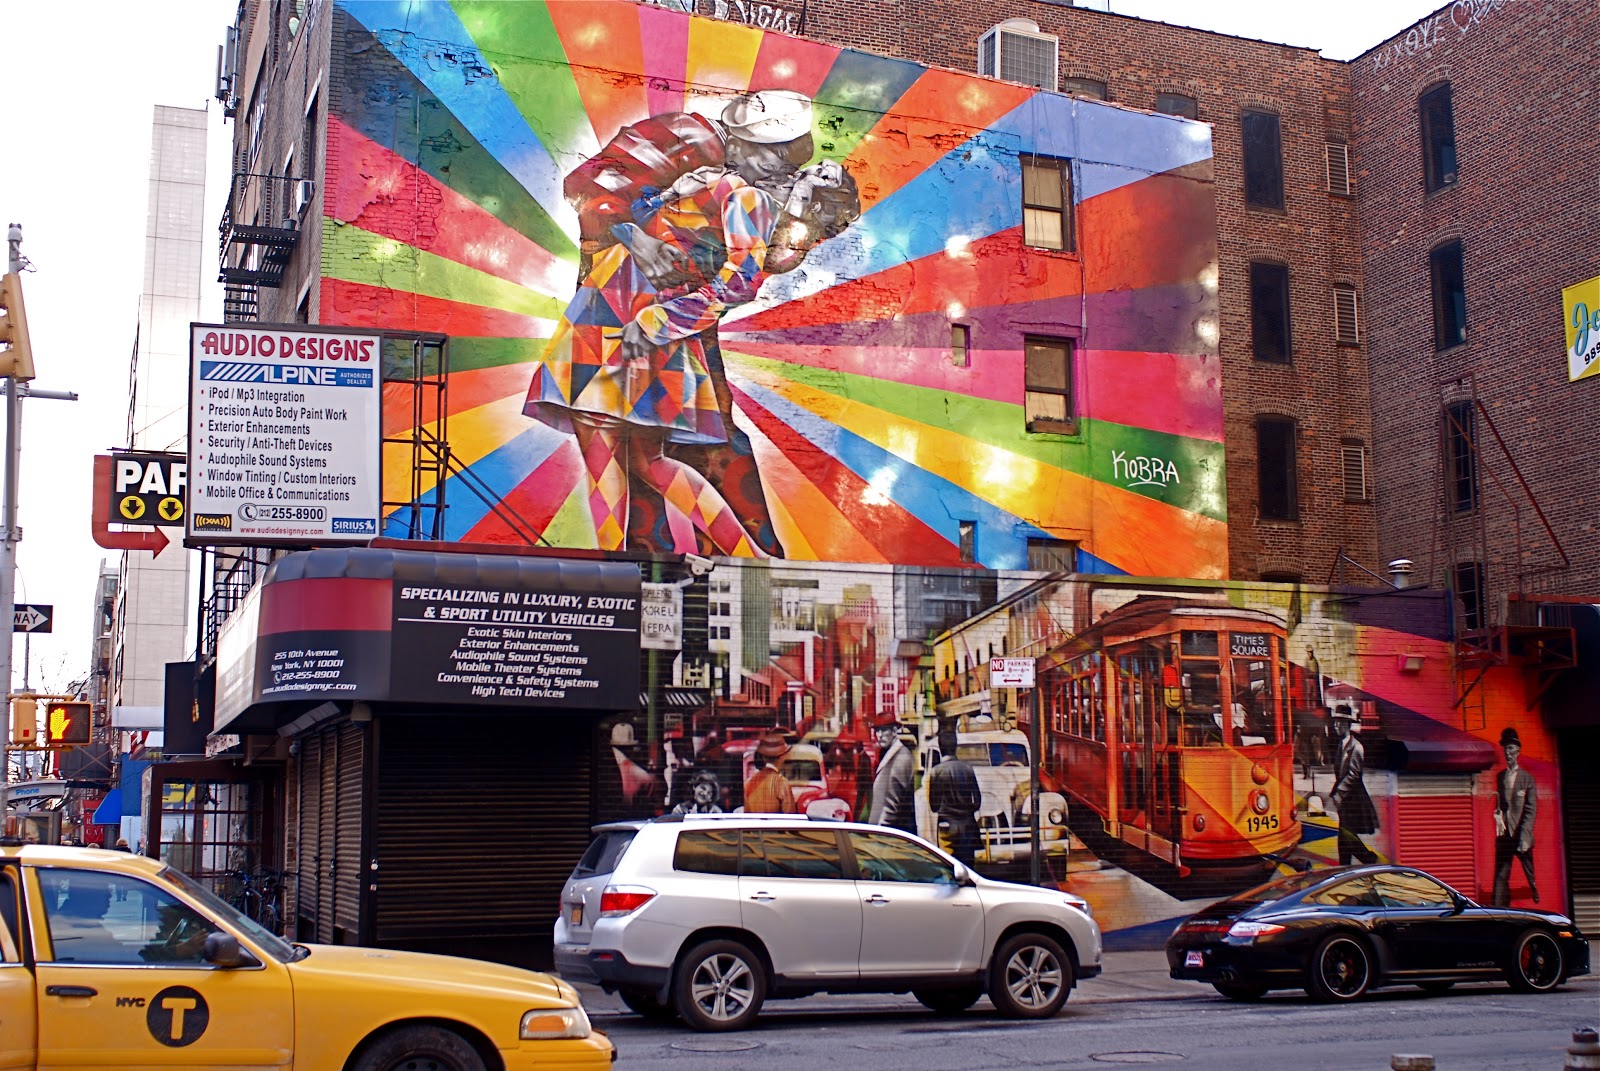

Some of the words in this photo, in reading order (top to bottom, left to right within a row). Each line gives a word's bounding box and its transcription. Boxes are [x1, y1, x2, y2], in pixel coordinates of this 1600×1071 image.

[201, 332, 275, 357] AUDIO
[280, 336, 375, 362] DESIGNS
[247, 365, 337, 385] ALPINE
[209, 387, 229, 399] iPod
[236, 388, 255, 402] Mp3
[257, 389, 305, 404] Integration
[208, 404, 251, 416] Precision
[252, 405, 274, 418] Auto
[275, 406, 299, 421] Body
[300, 408, 323, 420] Paint
[325, 408, 348, 420] Work
[208, 420, 244, 432] Exterior
[246, 421, 311, 435] Enhancements
[208, 435, 245, 451] Security
[252, 437, 296, 450] Anti-Theft
[298, 439, 333, 452] Devices
[208, 452, 257, 468] Audiophile
[258, 453, 287, 467] Sound
[289, 455, 327, 470] Systems
[1111, 450, 1180, 484] KOBRA
[208, 469, 243, 482] Window
[245, 470, 276, 486] Tinting
[283, 471, 317, 484] Custom
[319, 473, 356, 485] Interiors
[207, 486, 236, 498] Mobile
[238, 486, 265, 499] Office
[267, 487, 274, 499] &
[276, 488, 350, 501] Communications
[271, 507, 324, 519] 255-8900
[334, 521, 365, 530] SIRIUS
[401, 587, 500, 604] SPECIALIZING
[503, 592, 520, 604] IN
[523, 593, 583, 609] LUXURY,
[587, 597, 637, 610] EXOTIC
[423, 606, 436, 619] &
[440, 607, 490, 620] SPORT
[492, 609, 548, 624] UTILITY
[551, 612, 616, 627] VEHICLES
[467, 627, 500, 638] Exotic
[502, 628, 526, 639] Skin
[527, 629, 572, 641] Interiors
[647, 622, 672, 633] FERA
[459, 638, 502, 649] Exterior
[503, 640, 580, 653] Enhancements
[1234, 635, 1265, 645] TIMES
[274, 651, 288, 660] 255
[288, 650, 304, 659] 10th
[304, 649, 339, 658] Avenue
[449, 649, 506, 662] Audiophile
[507, 652, 541, 663] Sound
[542, 653, 589, 665] Systems
[1231, 645, 1269, 657] SQUARE
[270, 664, 284, 672] New
[284, 661, 301, 670] York,
[302, 660, 316, 669] NY
[317, 660, 345, 668] 10001
[455, 662, 491, 672] Mobile
[494, 663, 534, 674] Theater
[536, 664, 583, 676] Systems
[992, 659, 1004, 670] NO
[281, 670, 341, 681] 212-255-8900
[437, 672, 504, 684] Convenience
[505, 675, 514, 685] &
[516, 675, 552, 688] Safety
[553, 677, 600, 689] Systems
[261, 682, 357, 695] www.audiodesignnyc.com
[471, 685, 496, 697] High
[499, 686, 523, 697] Tech
[524, 687, 566, 699] Devices
[1246, 815, 1279, 832] 1945
[115, 997, 146, 1008] NYC
[161, 997, 197, 1040] T
